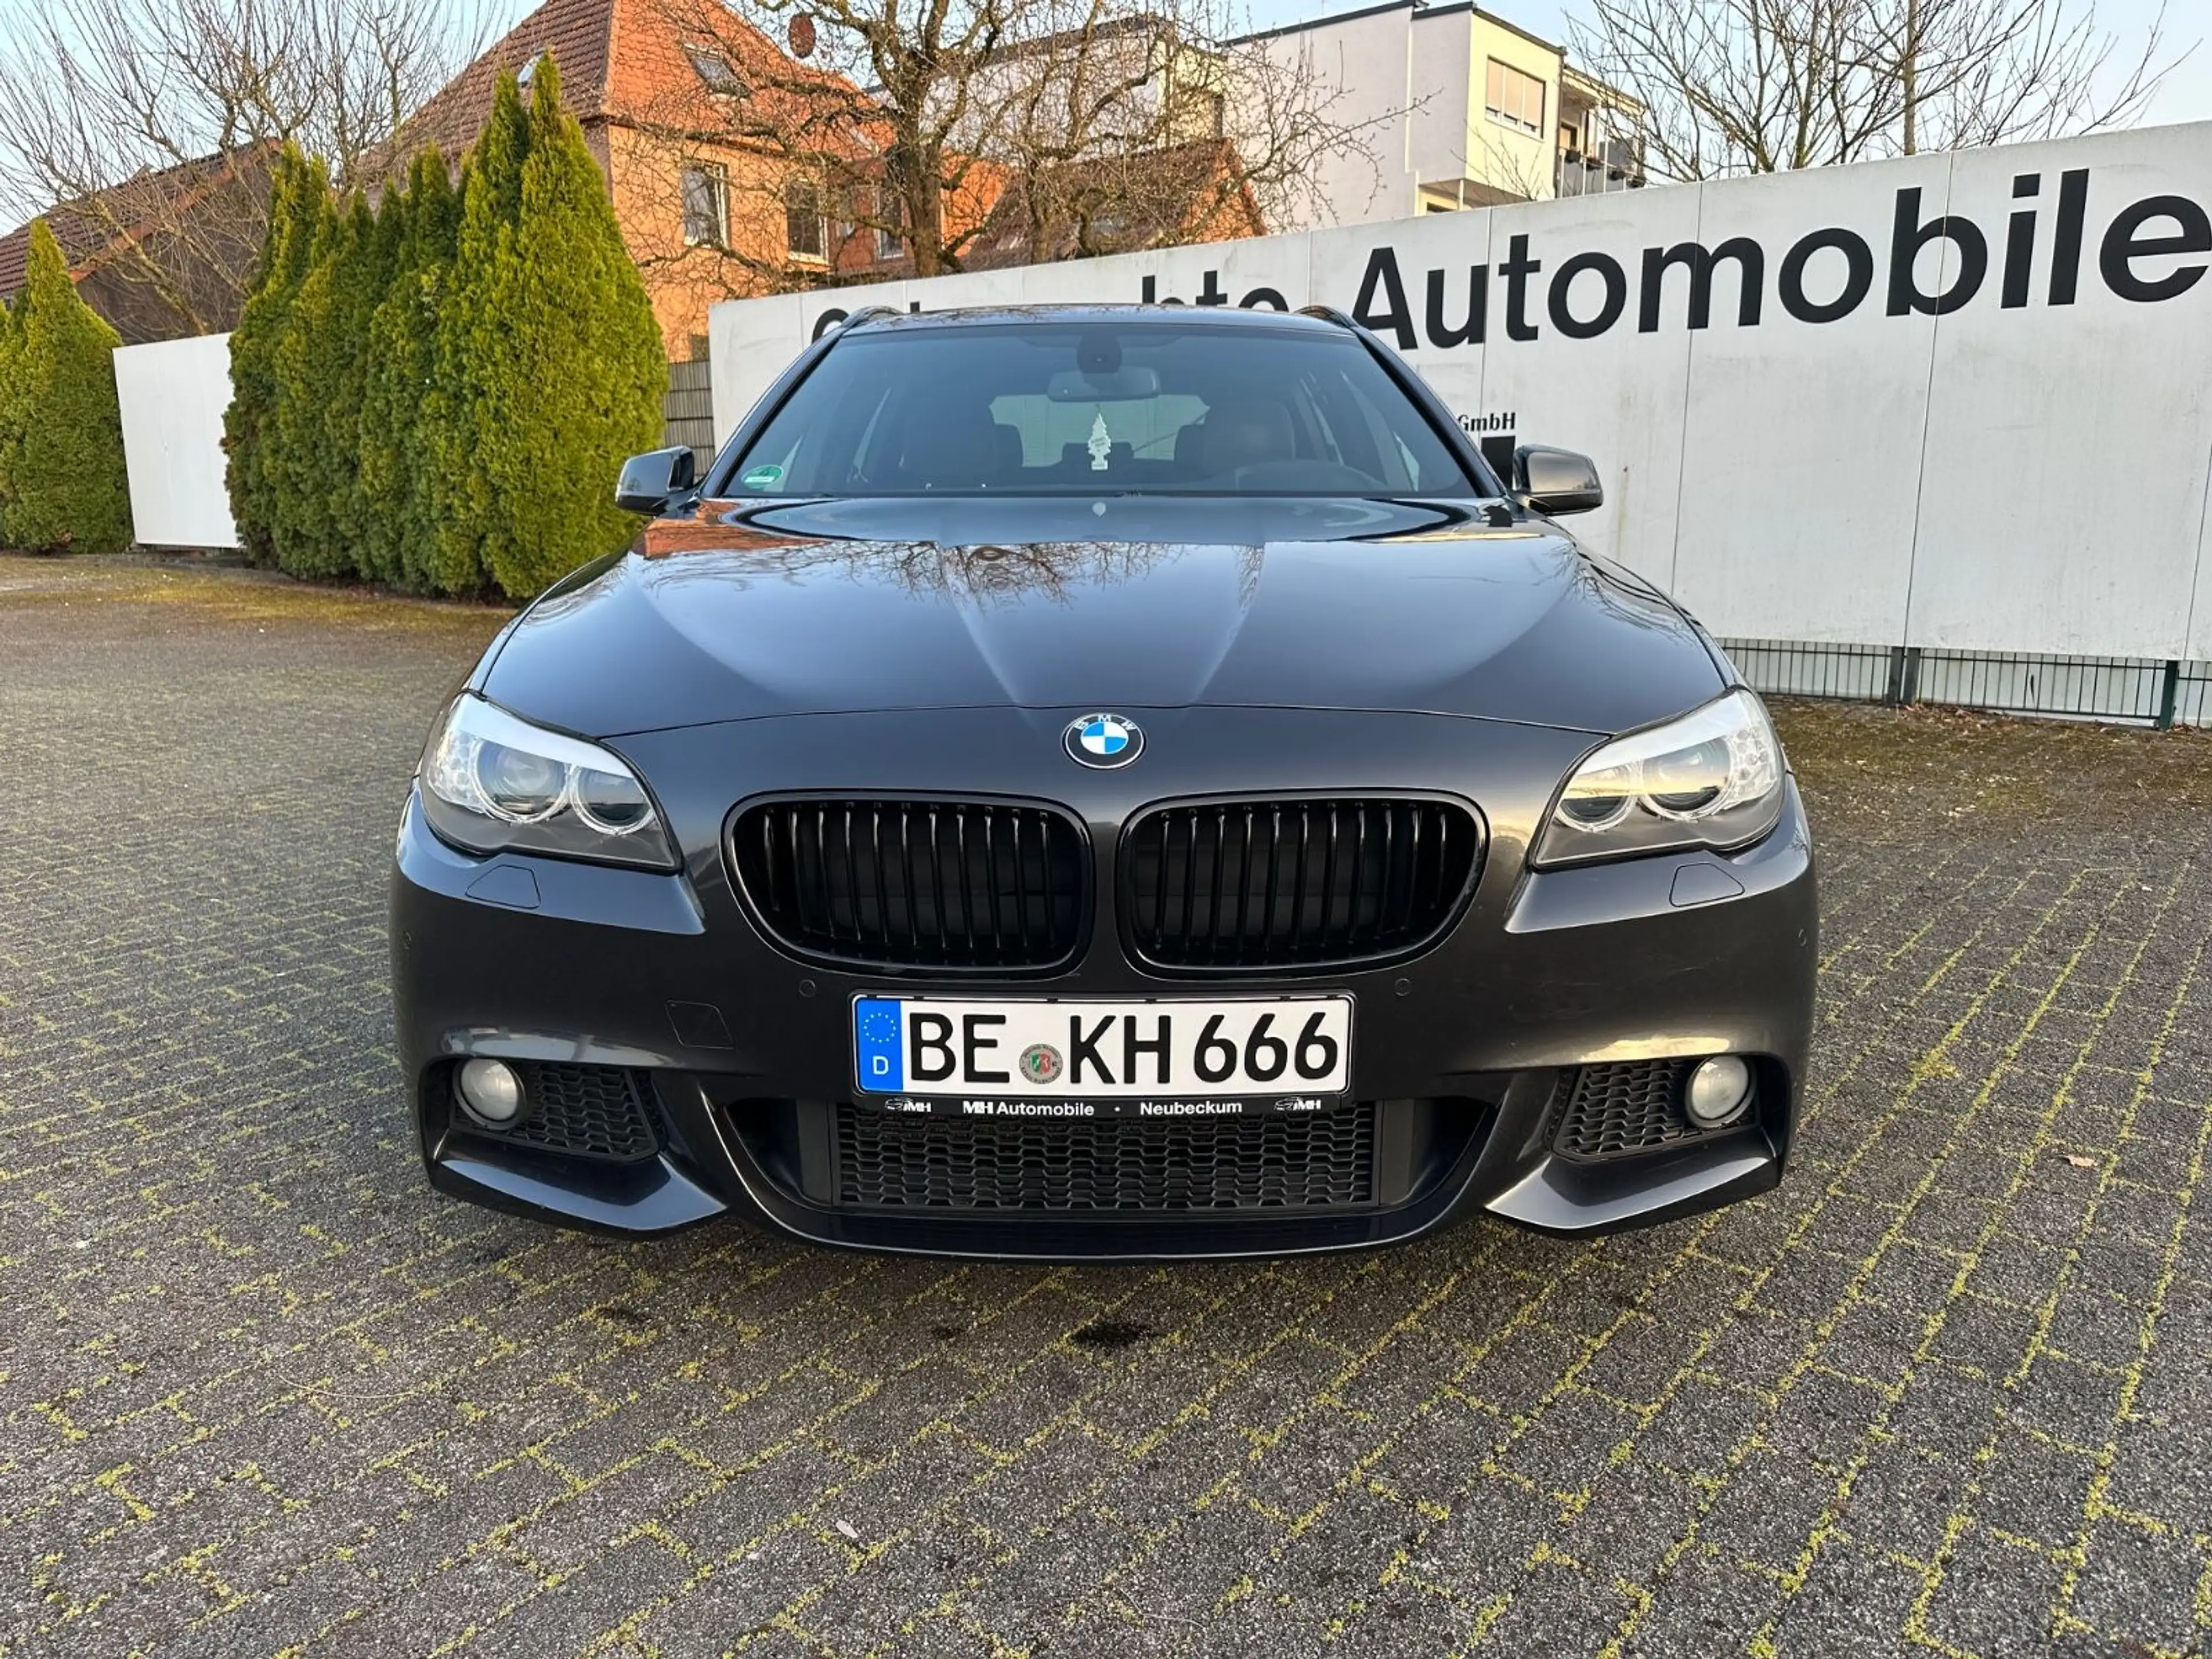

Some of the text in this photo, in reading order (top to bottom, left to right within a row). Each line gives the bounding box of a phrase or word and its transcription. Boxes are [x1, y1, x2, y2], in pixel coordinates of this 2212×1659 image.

[1351, 168, 2212, 350] Automobile
[1458, 412, 1516, 431] GmbH
[873, 1056, 888, 1075] D
[910, 1012, 1010, 1083] BE
[1069, 1015, 1171, 1084] KH
[1194, 1012, 1339, 1083] 666
[997, 1102, 1094, 1116] Automobile
[1141, 1100, 1243, 1116] Neubeckum
